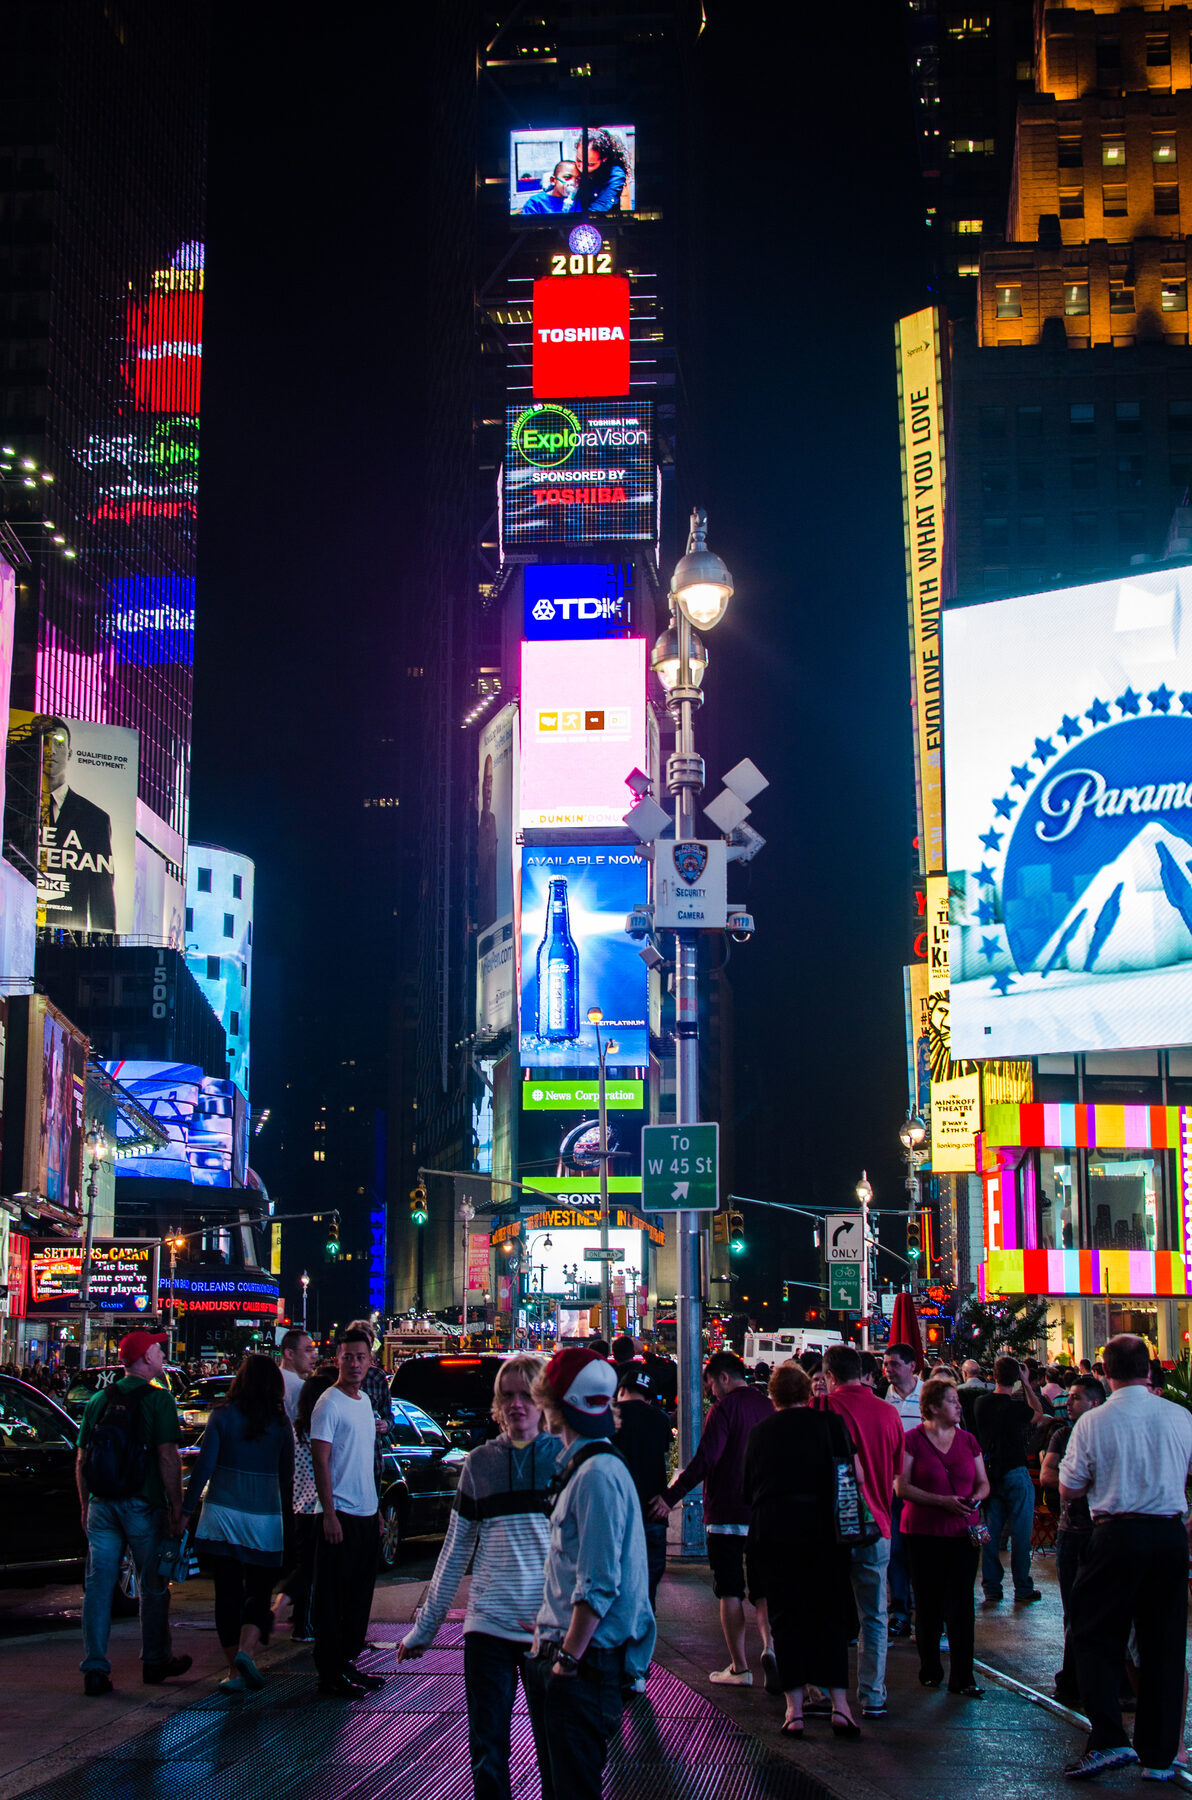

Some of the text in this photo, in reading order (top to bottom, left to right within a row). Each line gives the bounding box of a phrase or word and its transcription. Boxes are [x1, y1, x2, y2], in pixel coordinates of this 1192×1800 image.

[551, 253, 612, 275] 2012
[538, 326, 624, 343] TOSHIBA
[910, 386, 931, 447] LOVE
[523, 428, 647, 452] ExploraVision
[532, 470, 626, 482] SPONSORED BY
[913, 450, 934, 499] YOU
[532, 487, 627, 505] TOSHIBA
[915, 504, 936, 572] WHAT
[918, 577, 940, 642] WITH
[76, 750, 128, 763] QUALIFIED FOR
[78, 758, 127, 770] EMPLOYMENT.
[63, 830, 83, 850] A
[527, 855, 643, 865] AVAILABLE NOW
[675, 888, 706, 897] SECURITY
[677, 910, 705, 920] CAMERA
[545, 1090, 635, 1103] News Corpration
[934, 1098, 976, 1106] MINSKOFF
[671, 1135, 690, 1151] To
[648, 1157, 713, 1175] W 45 St
[109, 1247, 149, 1260] CATAN
[831, 1249, 858, 1258] ONLY
[117, 1260, 138, 1271] best
[88, 1284, 147, 1297] ever played.
[191, 1281, 235, 1292] ORLEANS
[189, 1300, 241, 1311] SANDUSKY
